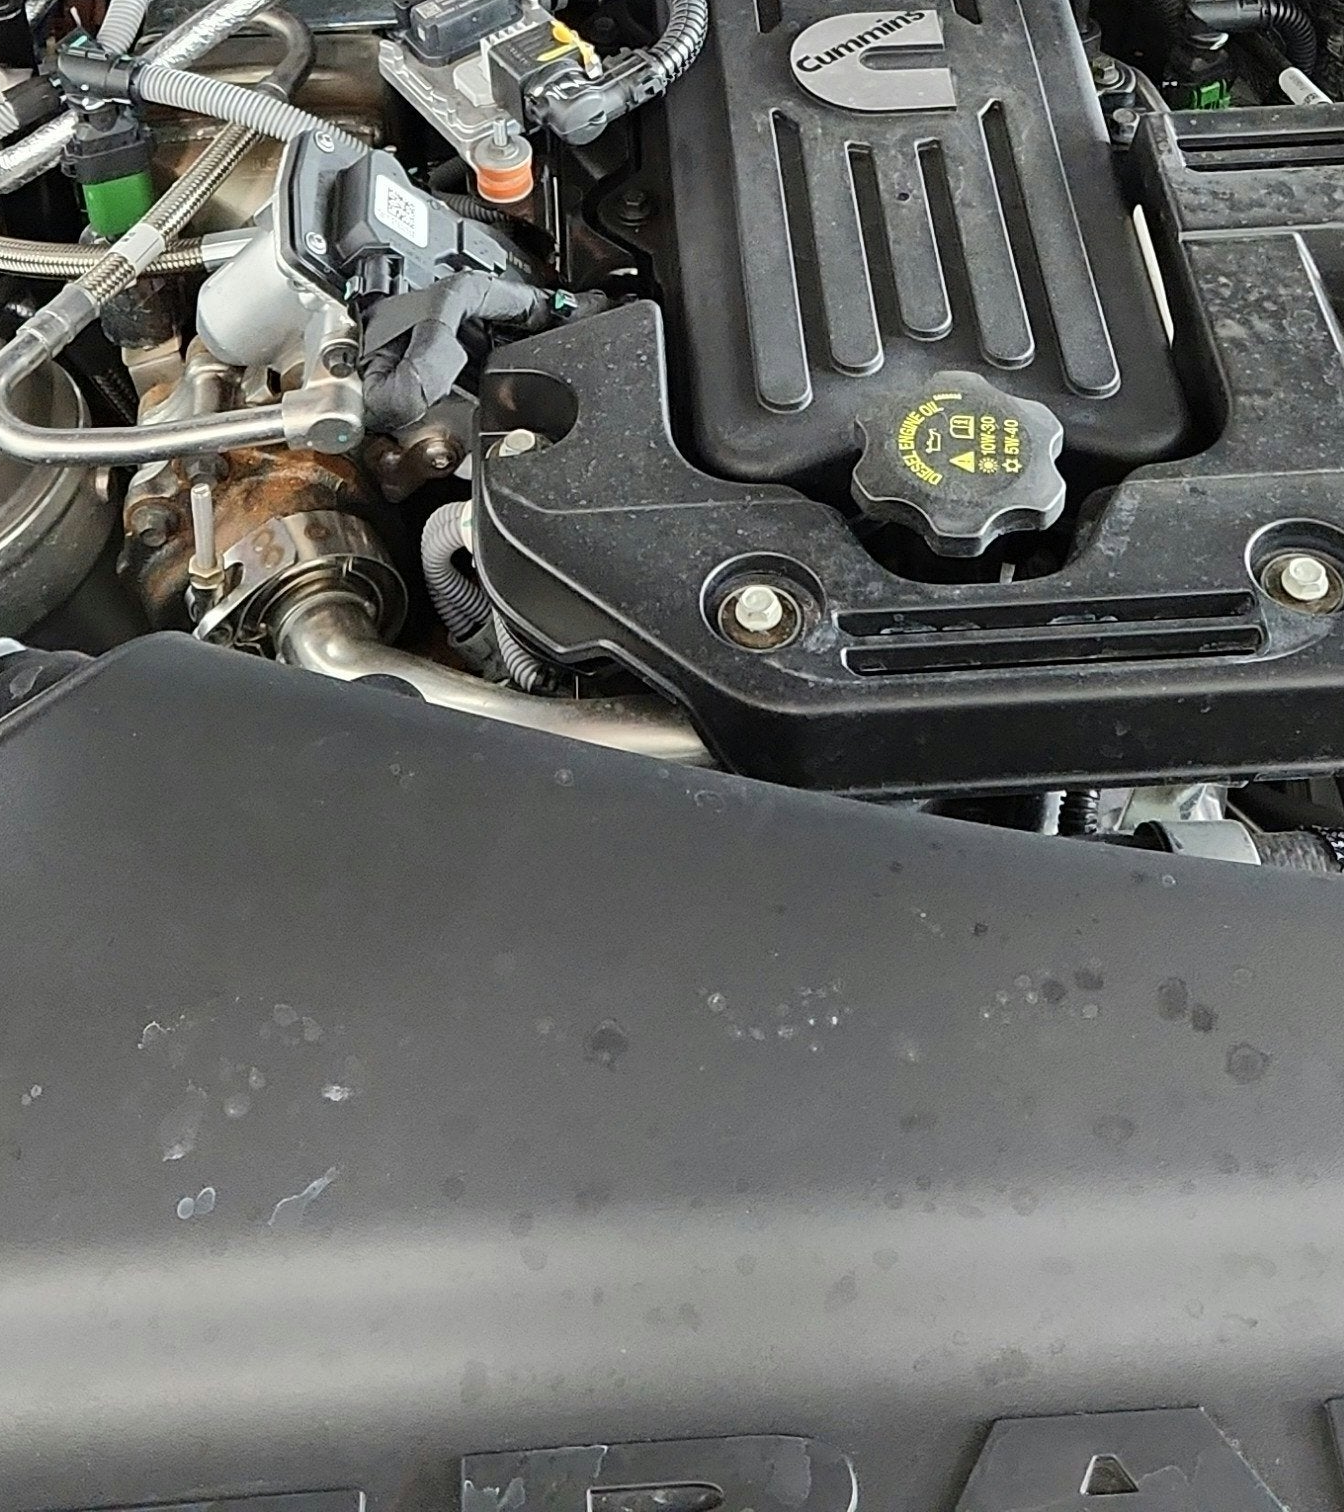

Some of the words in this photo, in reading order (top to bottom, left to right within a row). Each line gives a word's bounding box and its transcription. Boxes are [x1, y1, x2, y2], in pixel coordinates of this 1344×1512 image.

[796, 9, 926, 73] Cummins
[919, 400, 944, 417] OIL
[898, 411, 925, 450] ENGINE
[979, 416, 996, 456] 10W-30
[1003, 419, 1019, 455] 5W-40
[902, 450, 943, 486] DIESEL
